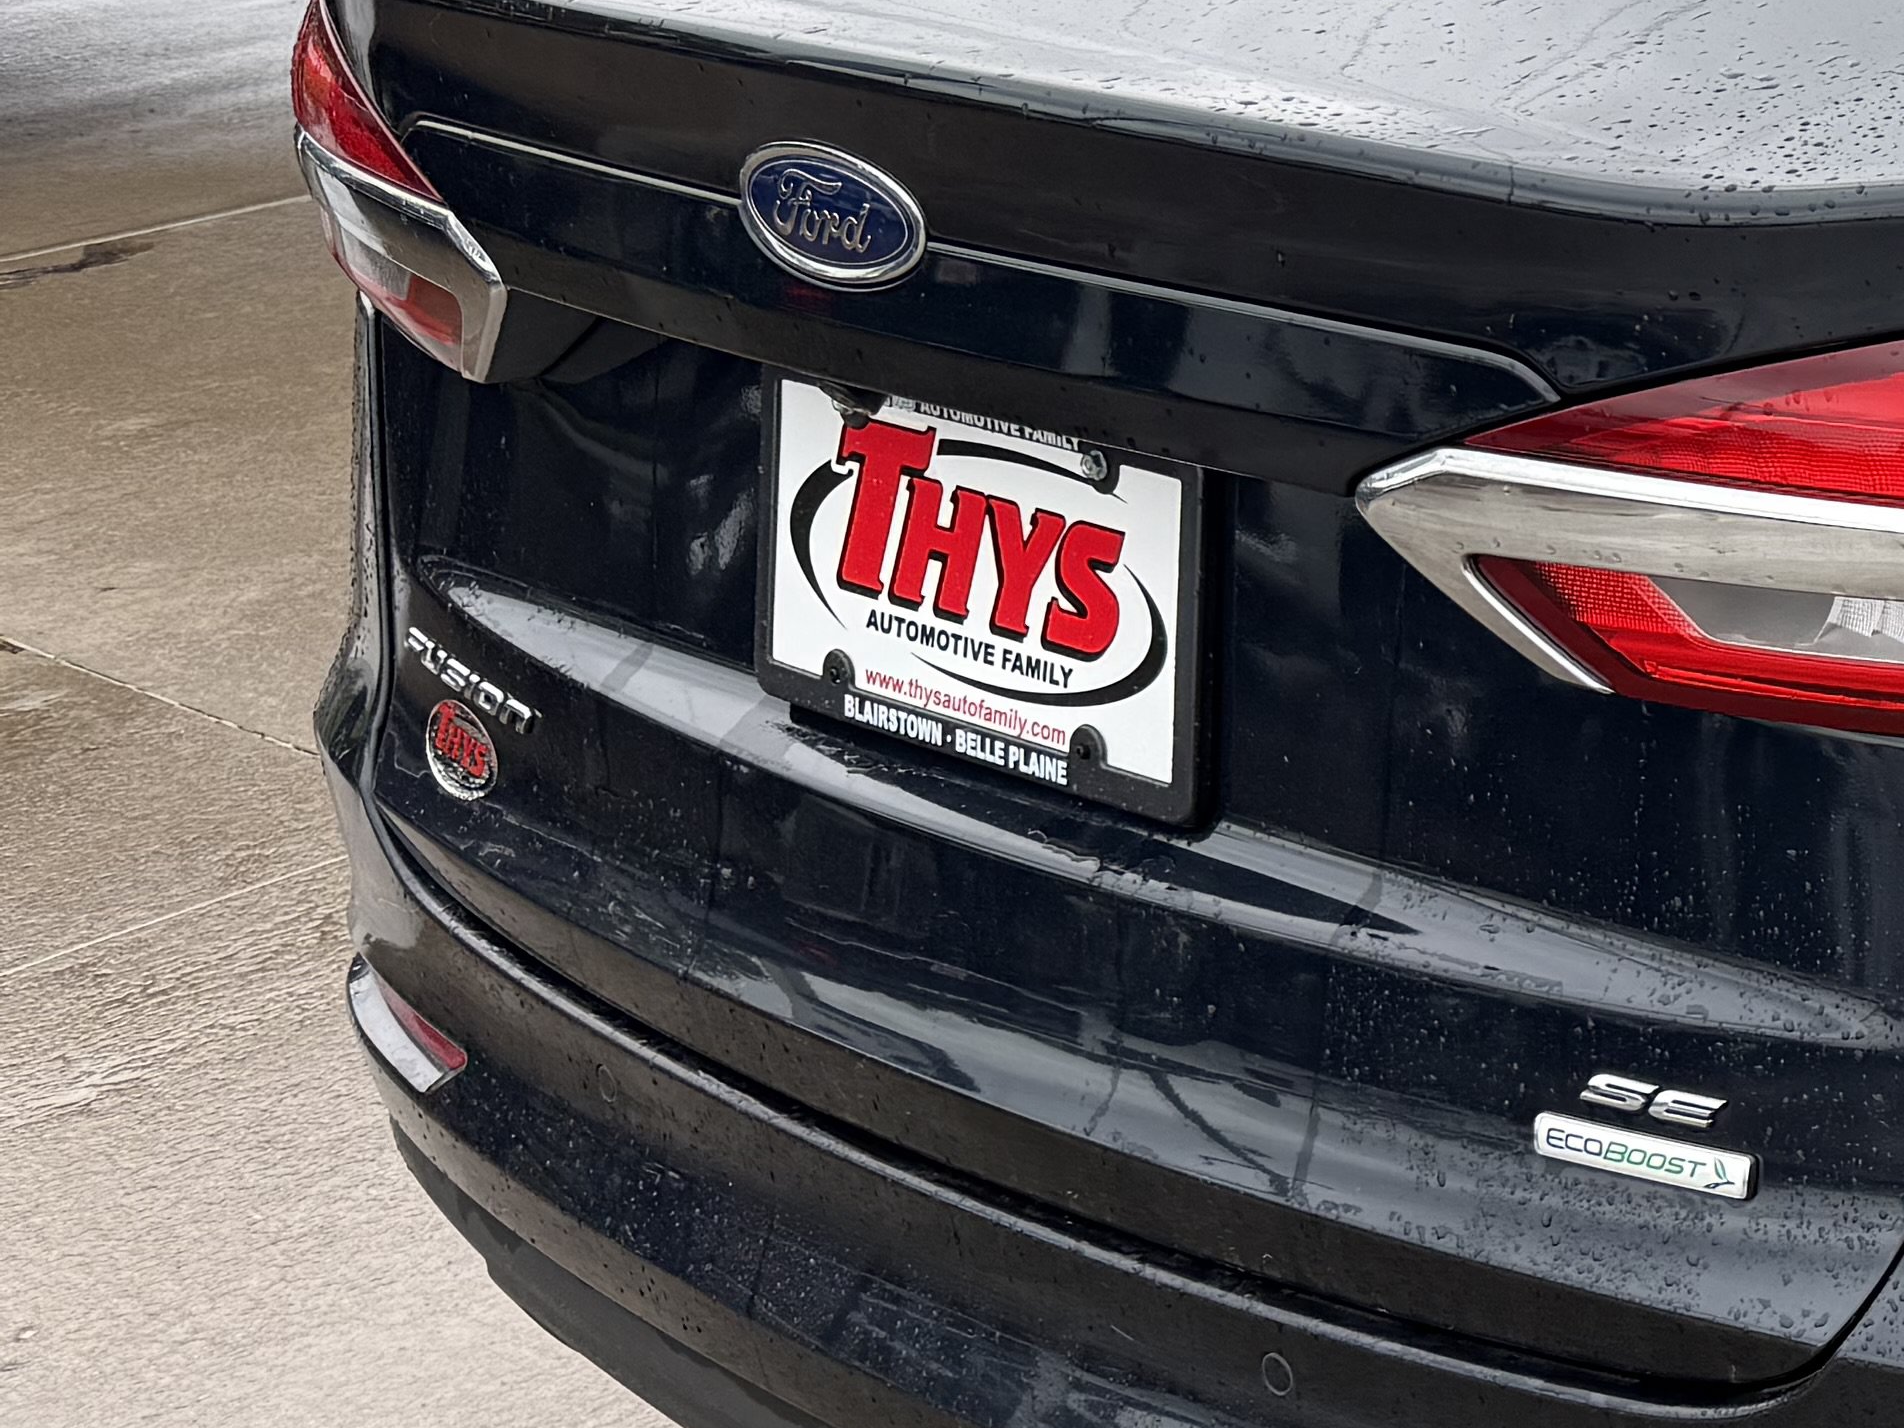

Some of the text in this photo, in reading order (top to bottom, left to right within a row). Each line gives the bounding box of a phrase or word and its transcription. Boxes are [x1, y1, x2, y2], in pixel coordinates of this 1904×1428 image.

[773, 168, 872, 254] Ford
[836, 421, 1126, 662] THYS
[866, 608, 1074, 690] AUTOMOTIVE FAMILY
[435, 702, 491, 780] THYS
[844, 693, 1068, 786] BLAIRSTOWN BELLE PLAINE
[865, 669, 1066, 746] www.thysautofamily.com
[1579, 1073, 1729, 1129] SE
[1546, 1127, 1707, 1179] ECOBOOST
